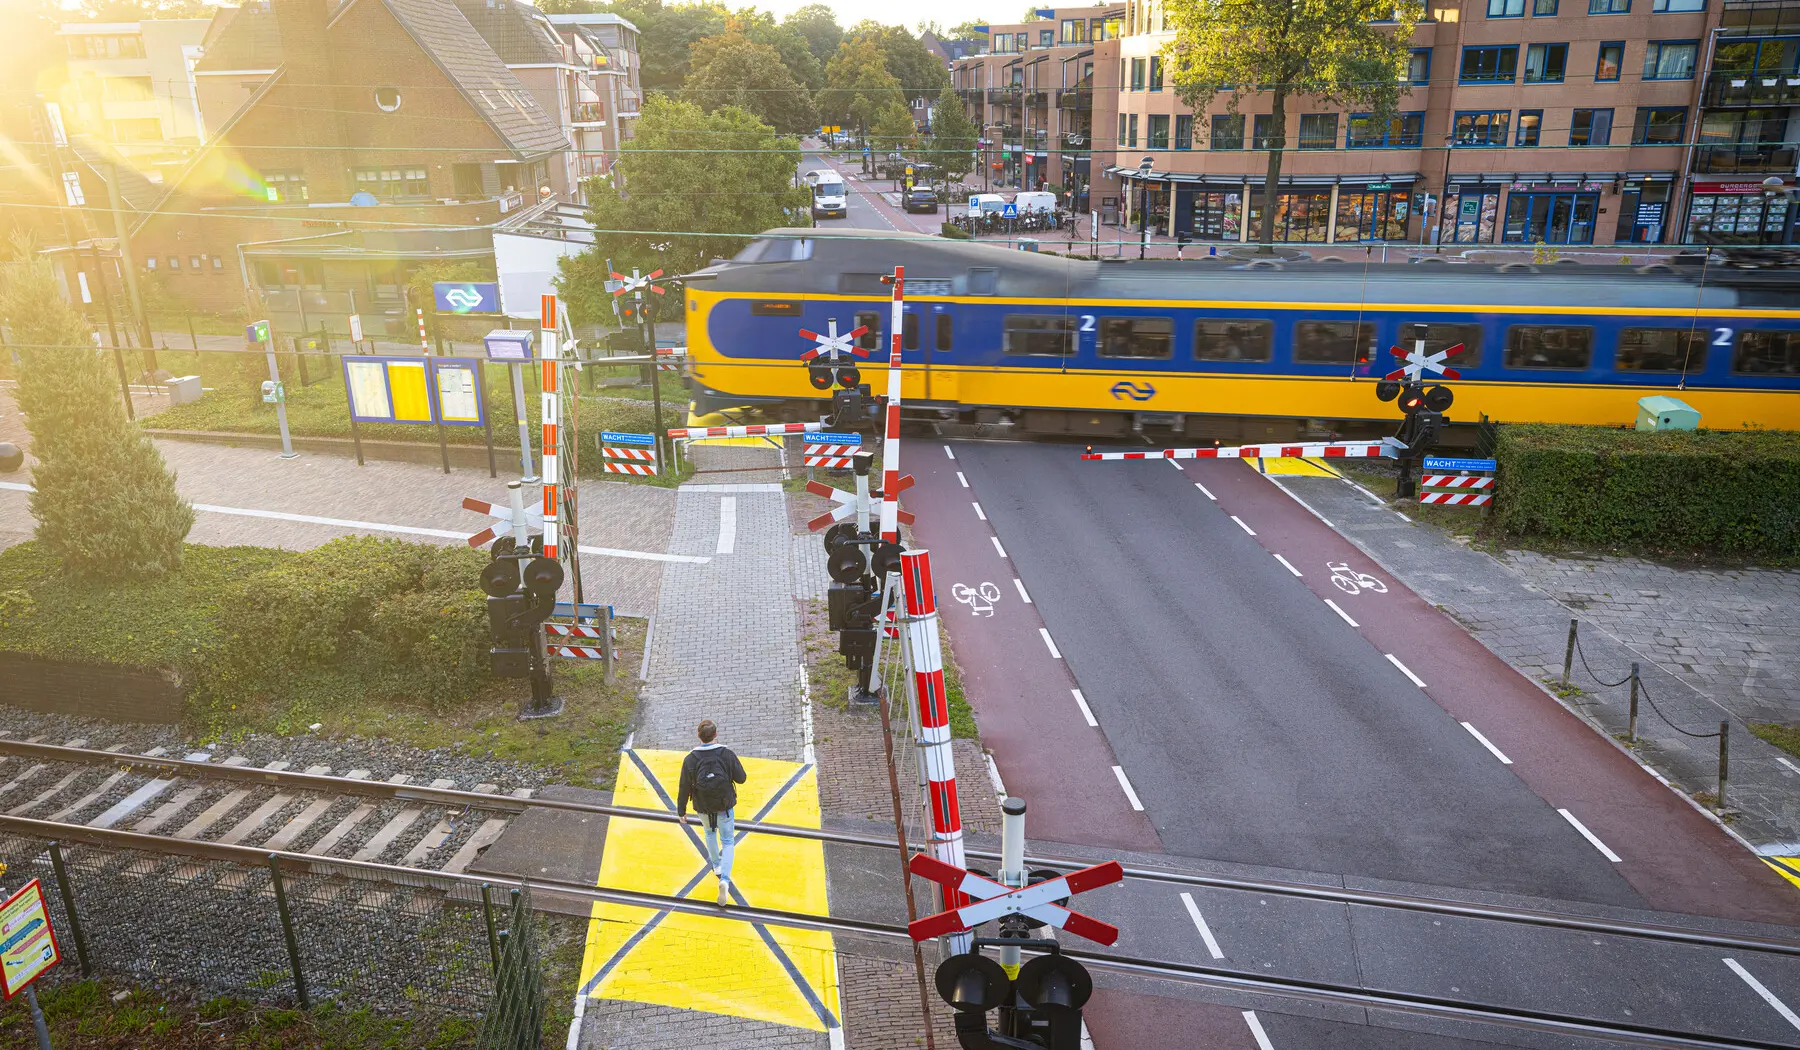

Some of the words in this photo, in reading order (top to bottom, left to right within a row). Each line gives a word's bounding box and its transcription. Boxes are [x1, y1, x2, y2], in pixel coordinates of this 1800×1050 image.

[1080, 315, 1096, 332] 2
[1712, 328, 1733, 346] 2
[805, 434, 829, 442] WACHT
[1426, 460, 1456, 468] WACHT
